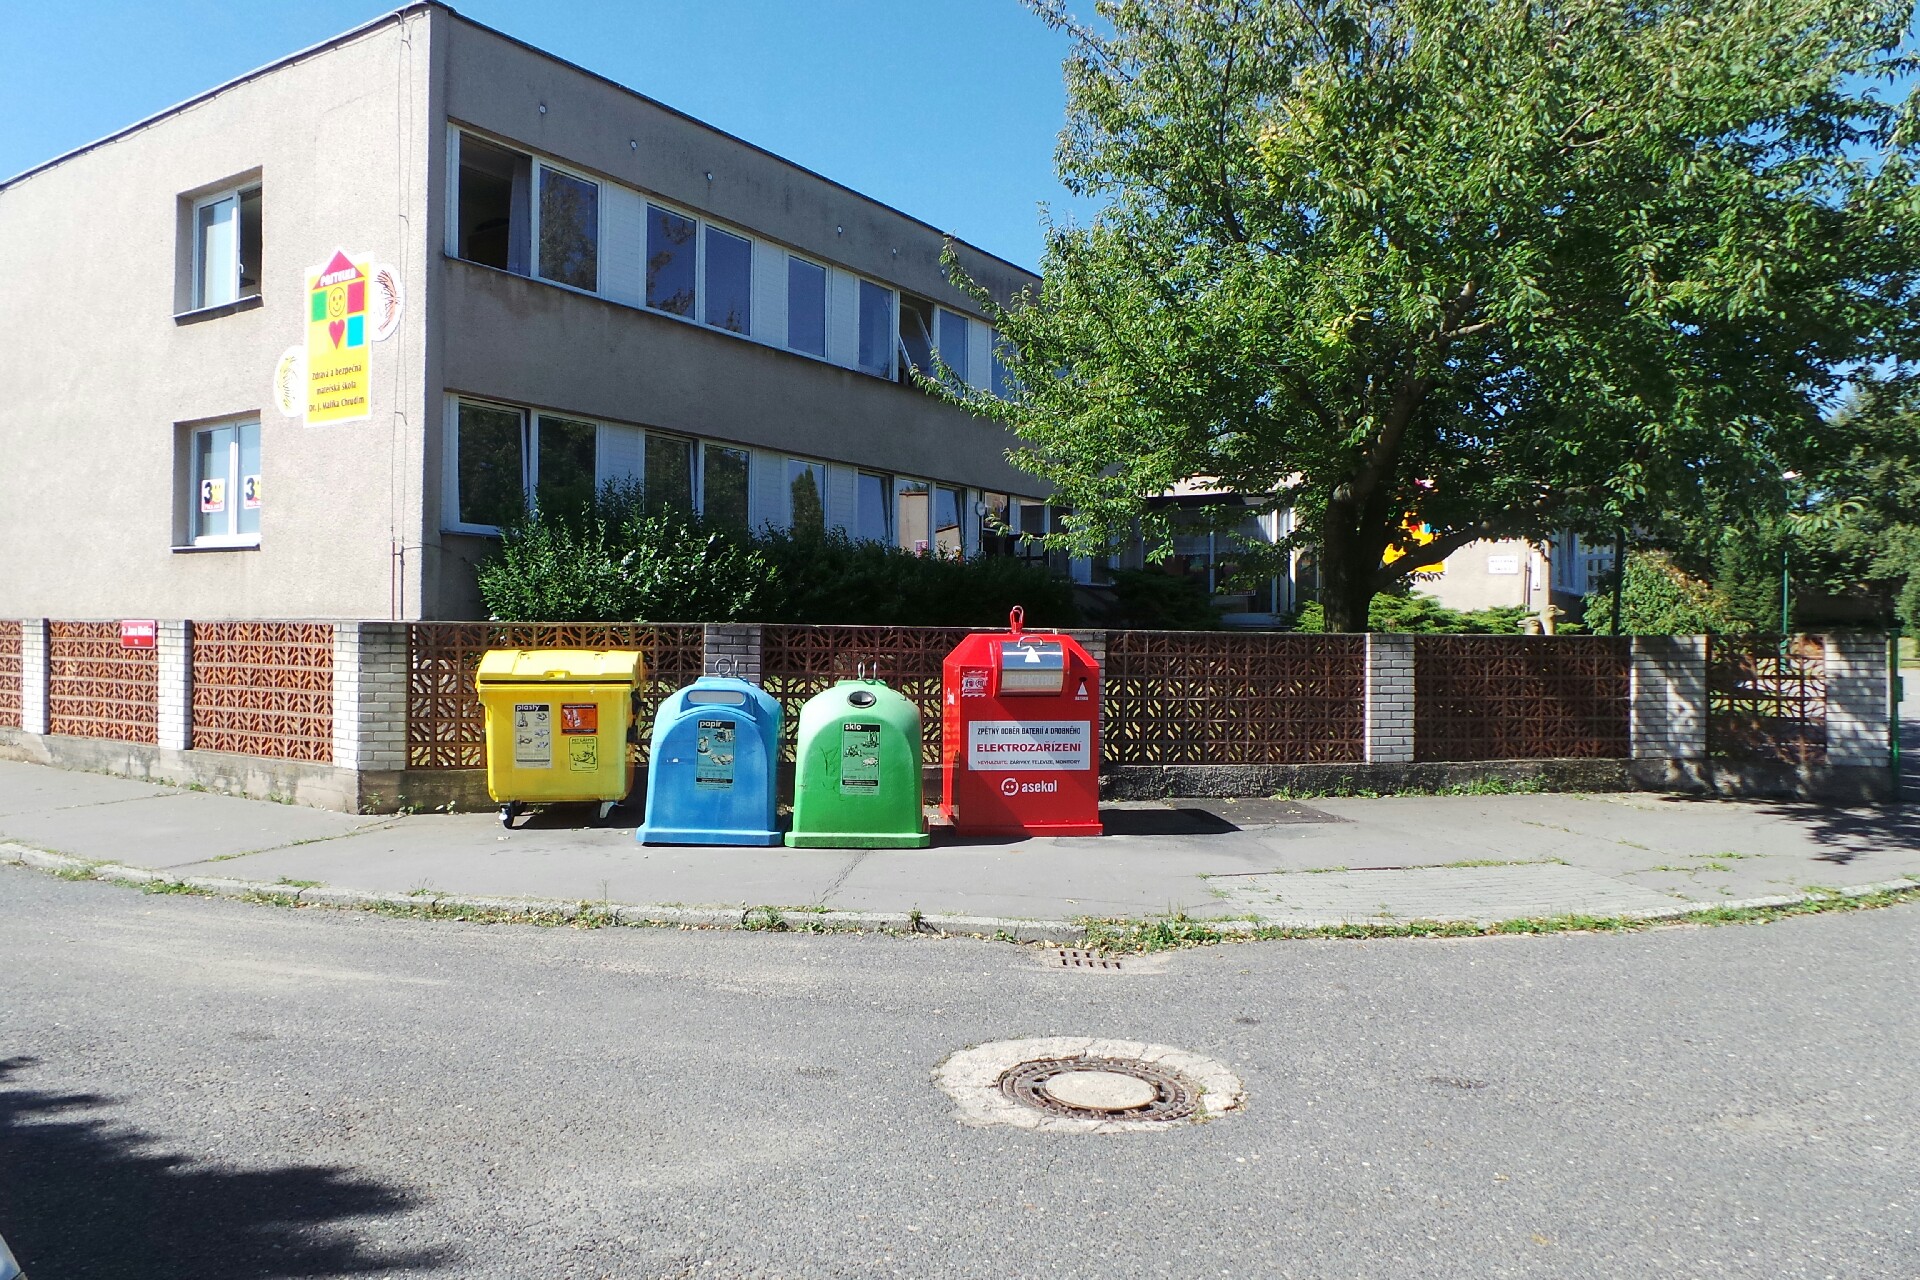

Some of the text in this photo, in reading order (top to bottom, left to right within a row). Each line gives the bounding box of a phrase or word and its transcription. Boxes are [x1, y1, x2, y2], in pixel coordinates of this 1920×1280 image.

[341, 396, 365, 407] Chrudim
[204, 481, 213, 504] 3
[246, 477, 256, 501] 3
[516, 704, 540, 712] plasty
[845, 722, 862, 730] sklo
[977, 726, 1000, 735] ZPĚTNÝ
[1001, 726, 1020, 735] ODBĚR
[1044, 727, 1049, 735] A
[1050, 725, 1081, 735] DROBNÉHO
[976, 741, 1082, 753] ELEKTROZAŘÍZENÍ
[1021, 780, 1058, 793] asekol
